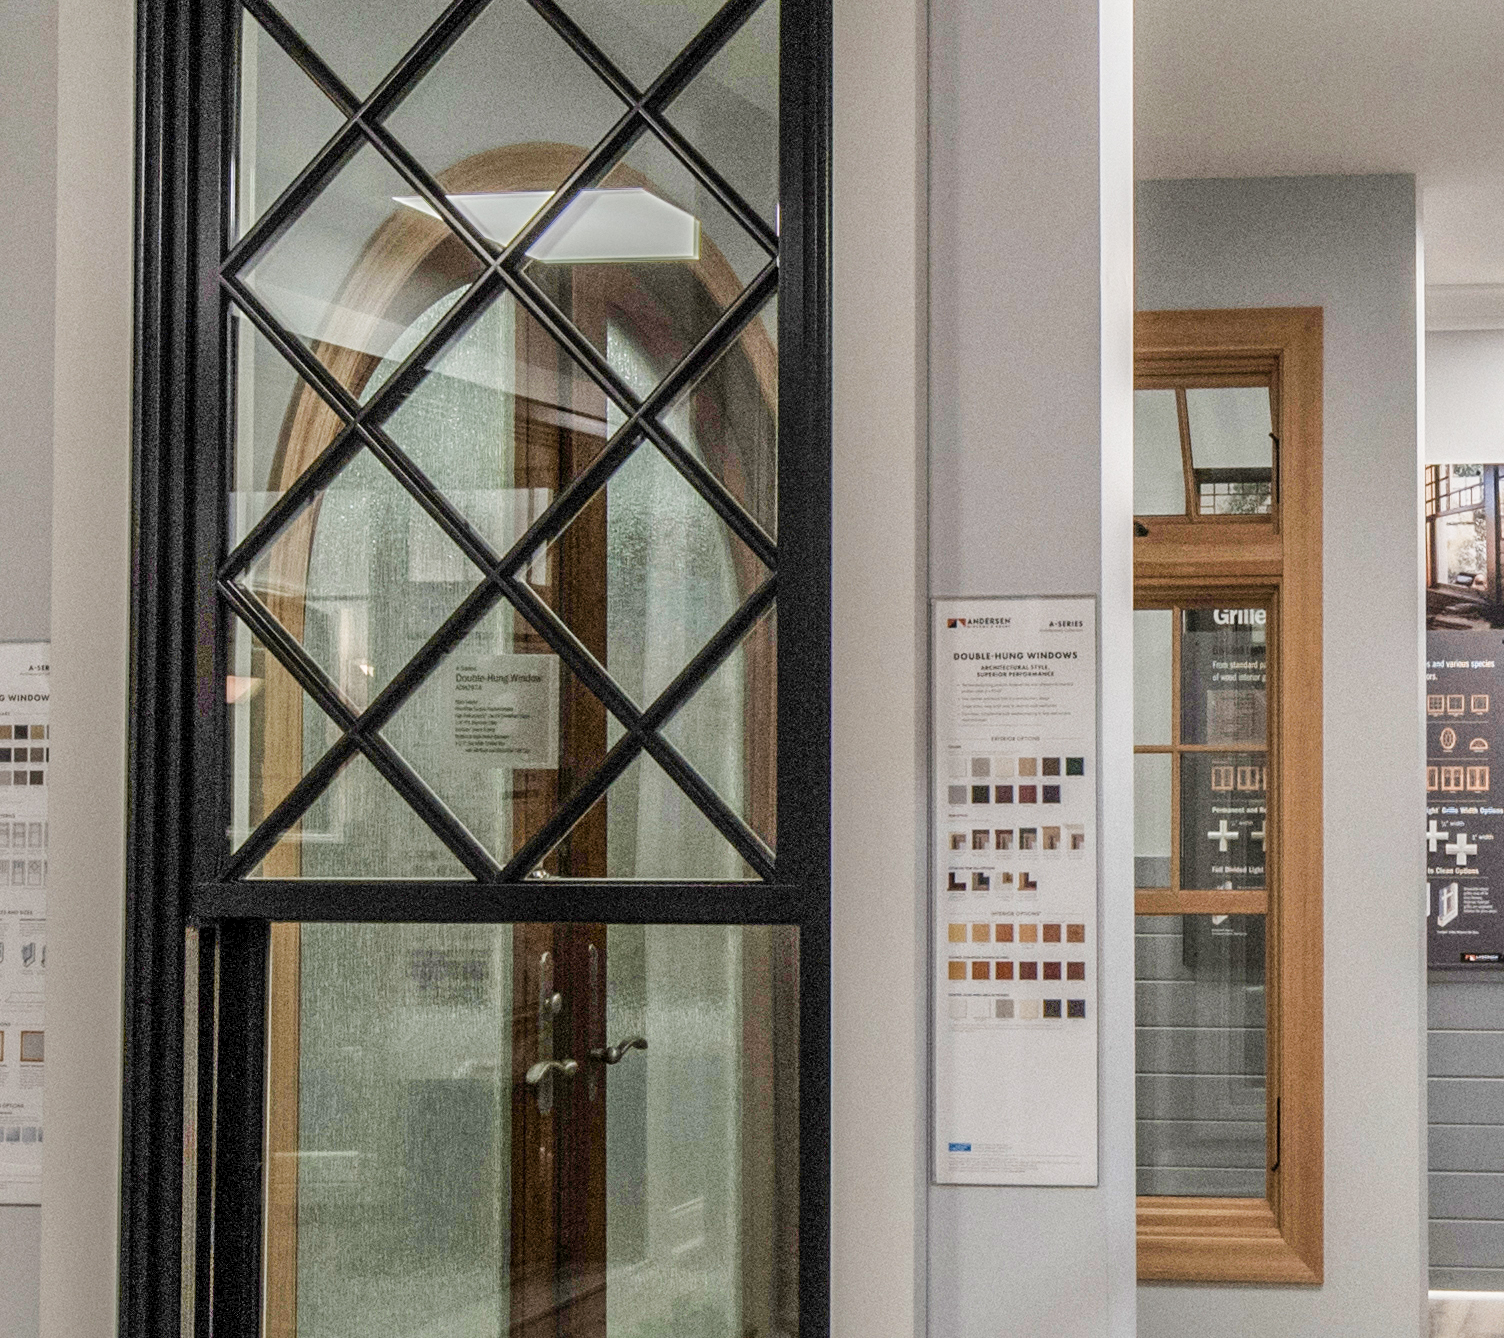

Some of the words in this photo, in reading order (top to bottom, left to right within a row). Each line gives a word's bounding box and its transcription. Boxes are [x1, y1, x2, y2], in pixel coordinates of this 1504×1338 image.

[967, 617, 1011, 625] ANDERSEN
[953, 652, 1024, 661] DOUBLE-HUNG
[1027, 651, 1078, 660] WINDOWS
[1230, 660, 1258, 669] standard
[1446, 660, 1470, 668] various
[1471, 660, 1495, 669] species
[1460, 806, 1479, 814] Width
[1480, 806, 1504, 816] Options
[1455, 867, 1480, 876] Options
